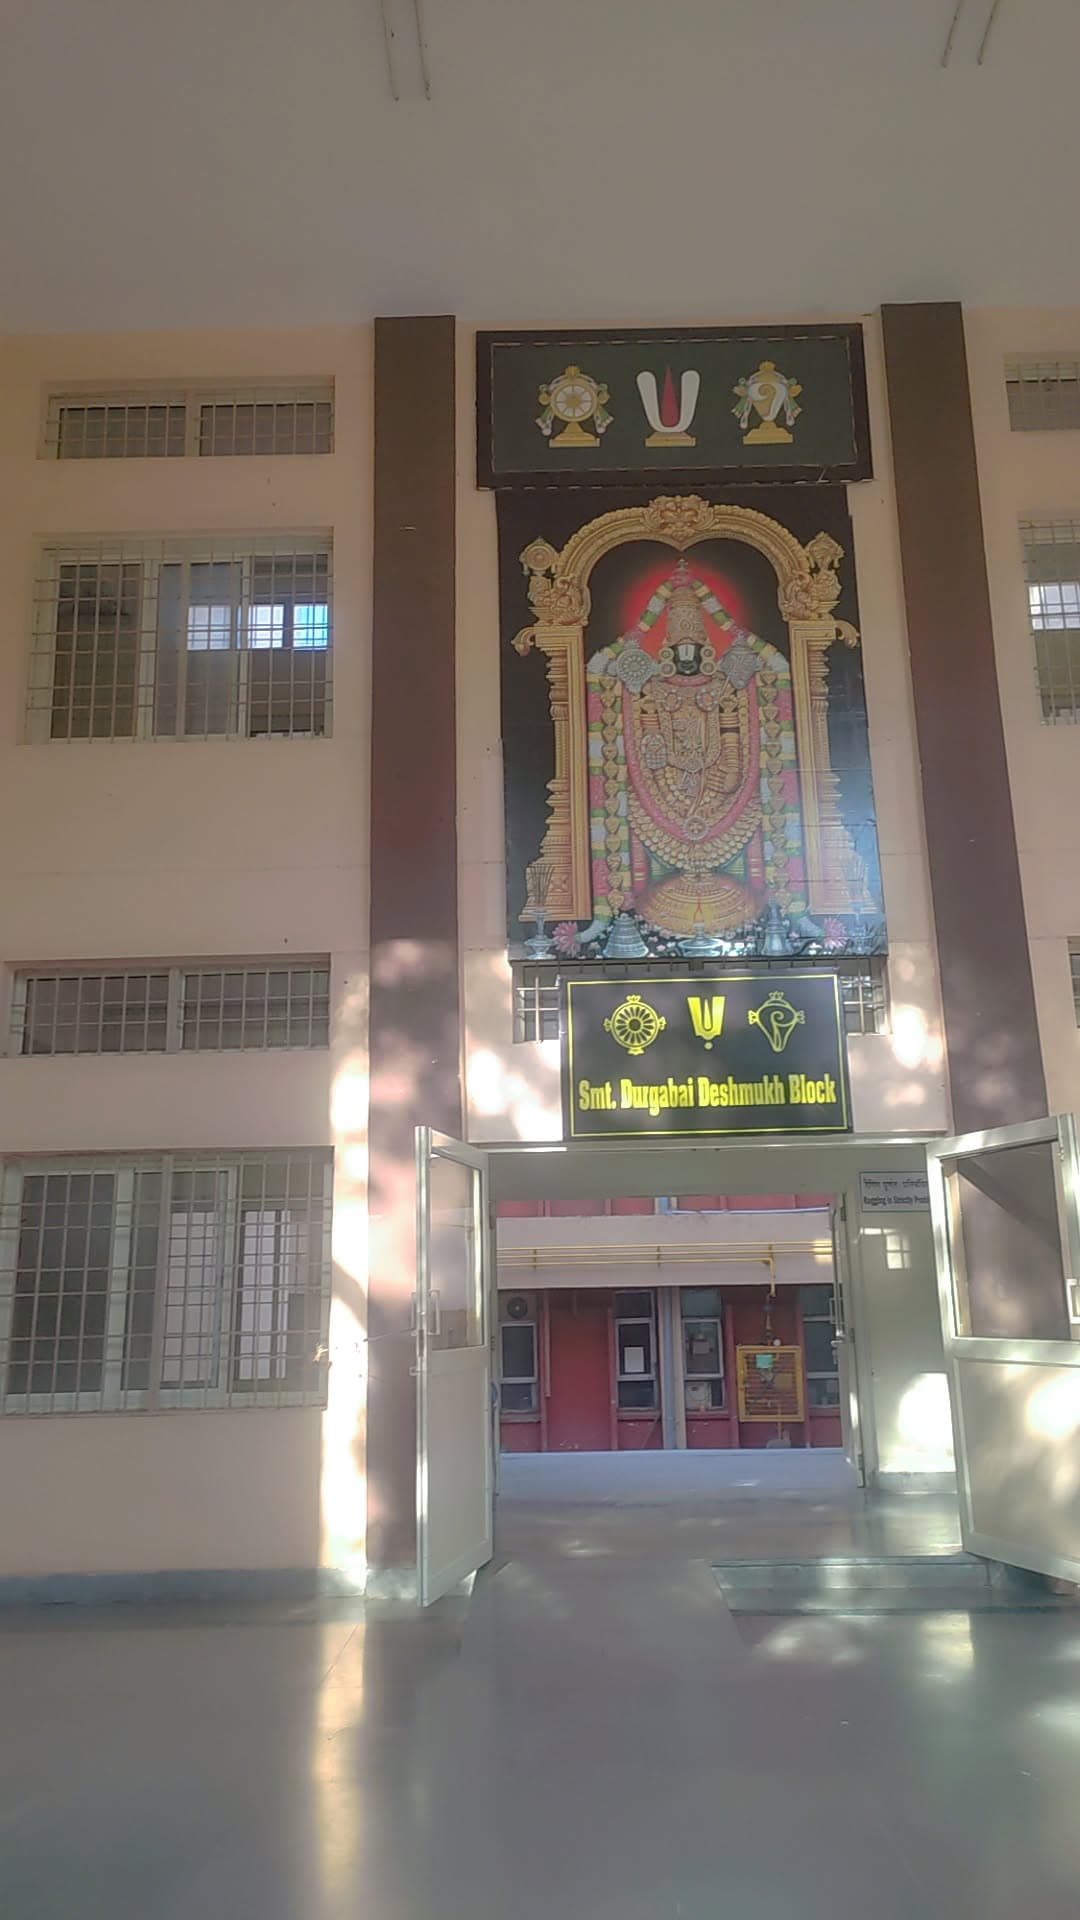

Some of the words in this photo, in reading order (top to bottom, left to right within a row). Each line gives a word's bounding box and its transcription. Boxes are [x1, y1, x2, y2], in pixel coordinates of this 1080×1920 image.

[579, 1080, 616, 1110] Smt.
[620, 1077, 693, 1116] Durgabai
[697, 1074, 785, 1107] Deshmukh
[788, 1073, 836, 1104] Block
